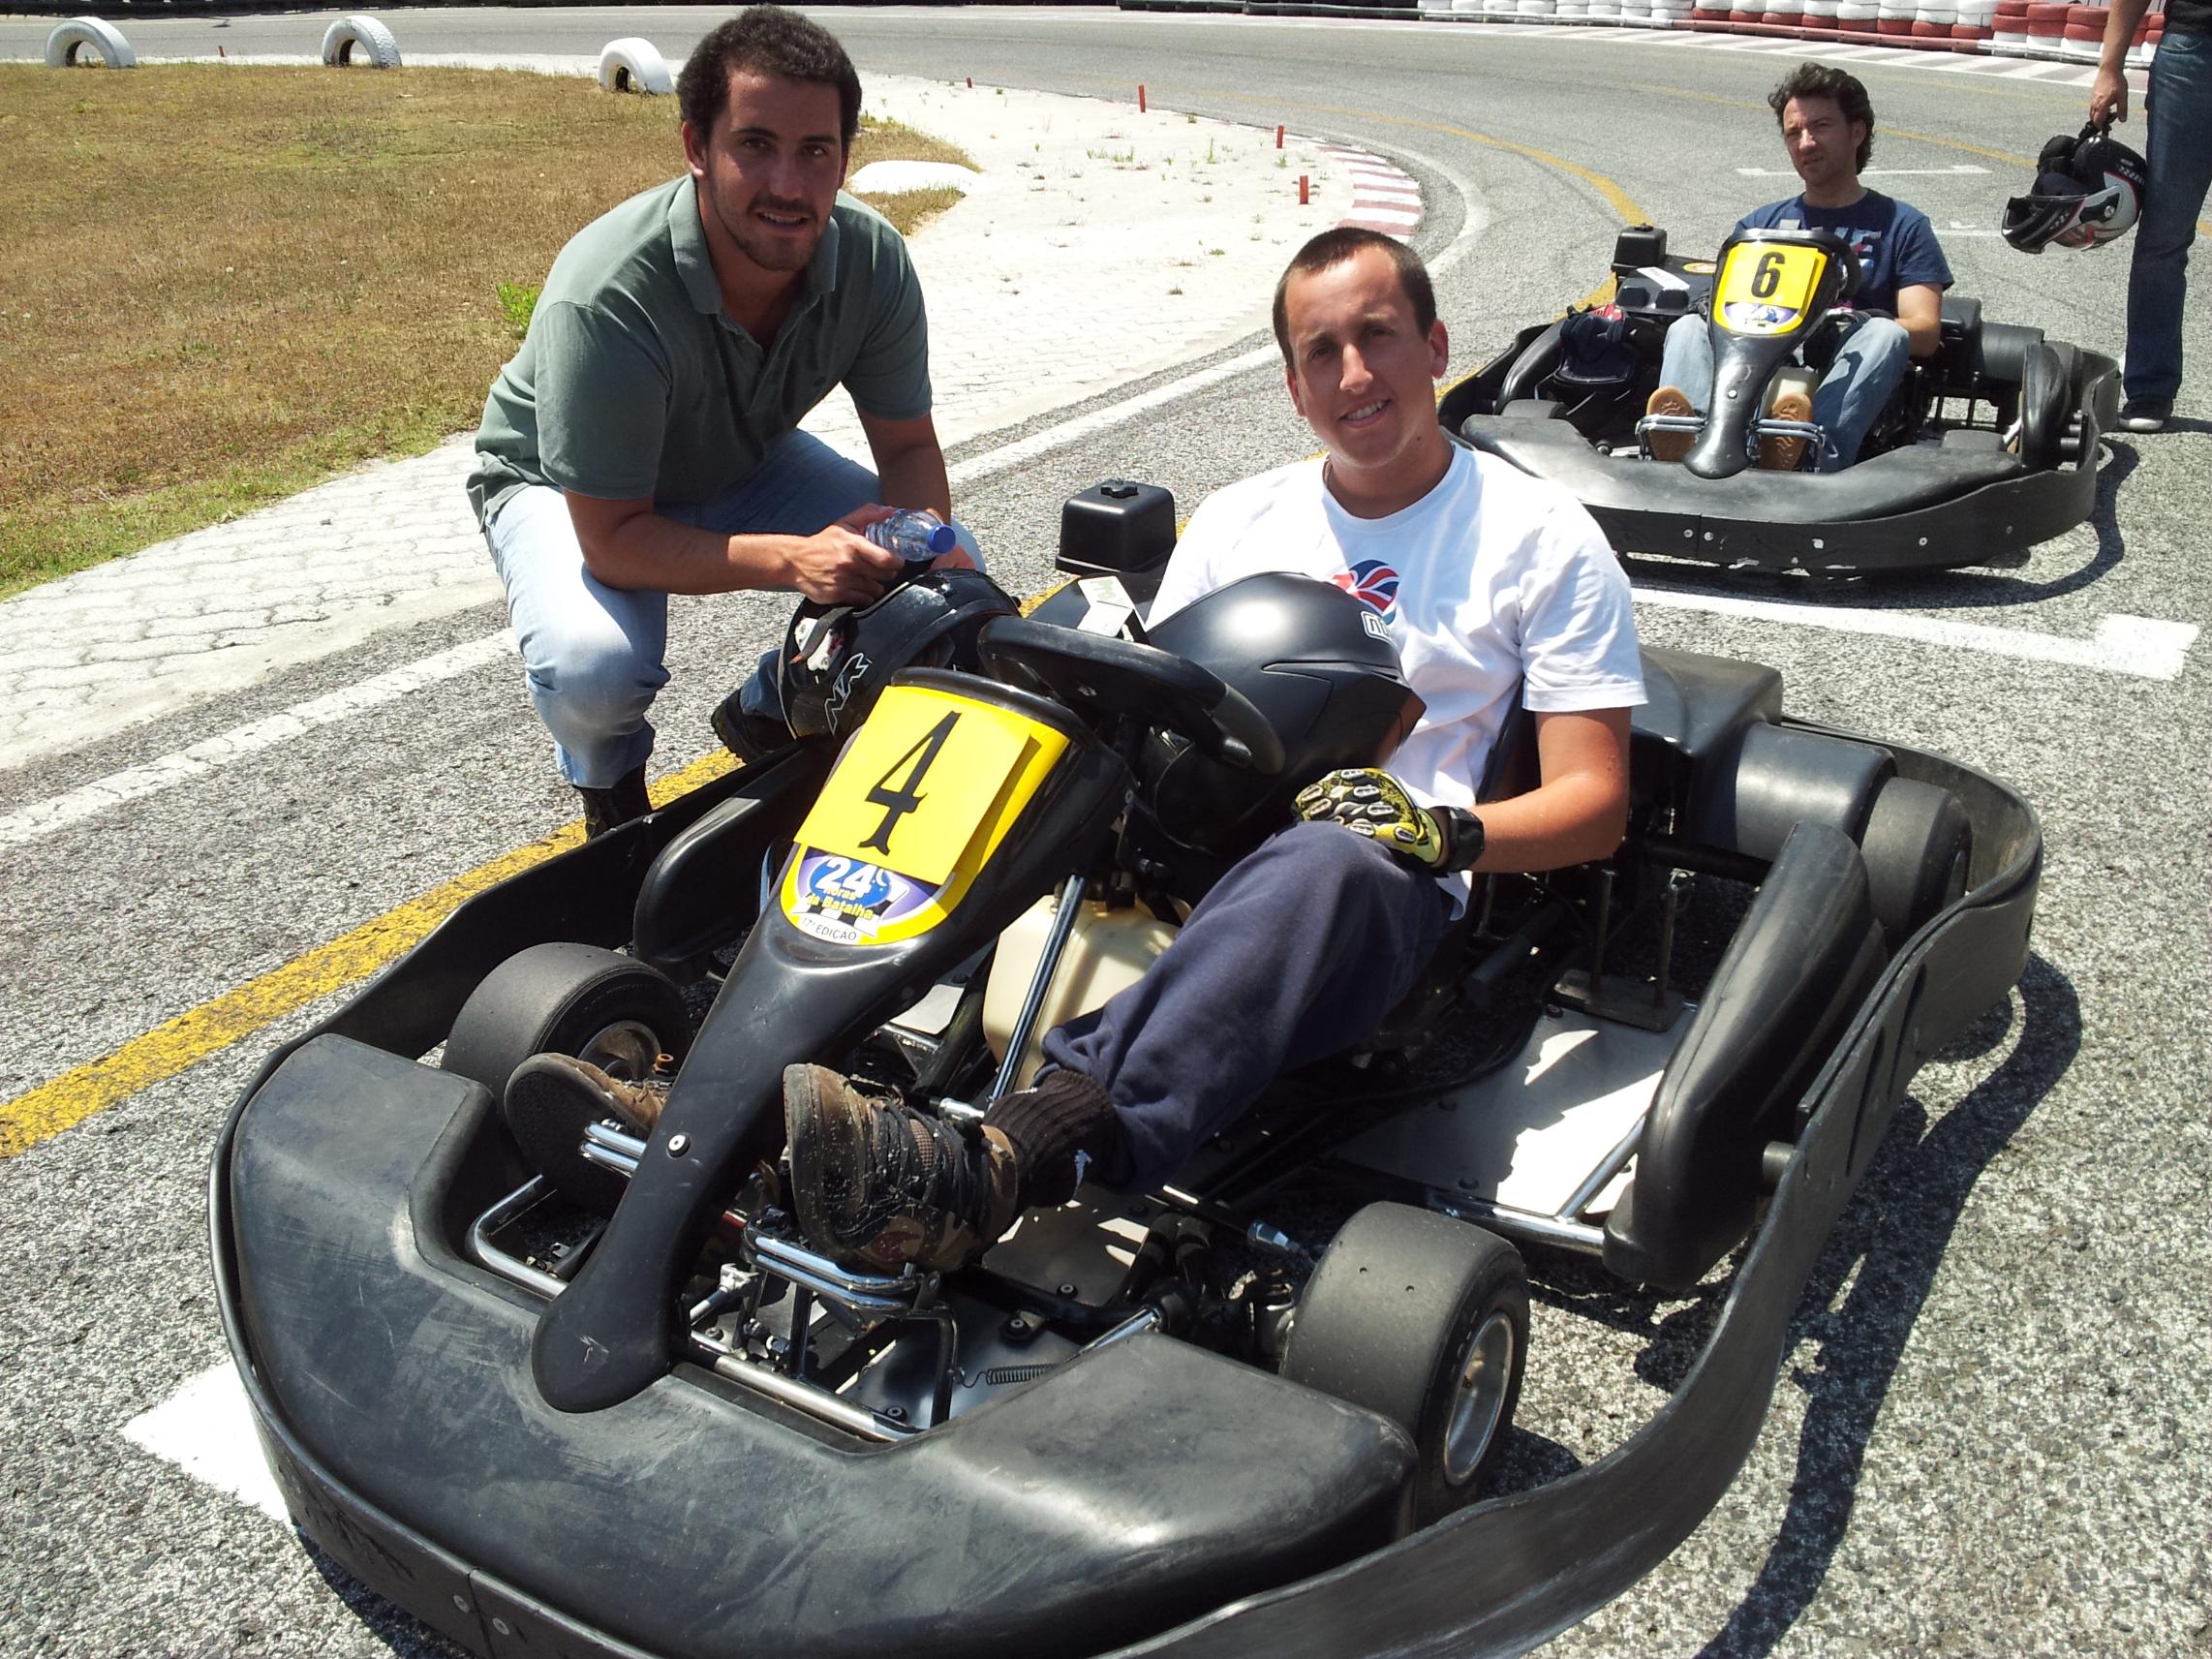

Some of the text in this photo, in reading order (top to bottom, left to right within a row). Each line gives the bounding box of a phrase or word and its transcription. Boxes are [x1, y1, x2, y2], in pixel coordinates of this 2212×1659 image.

[1750, 251, 1785, 298] 6
[857, 710, 963, 857] 4
[814, 856, 878, 897] 24
[821, 896, 874, 921] Batalha
